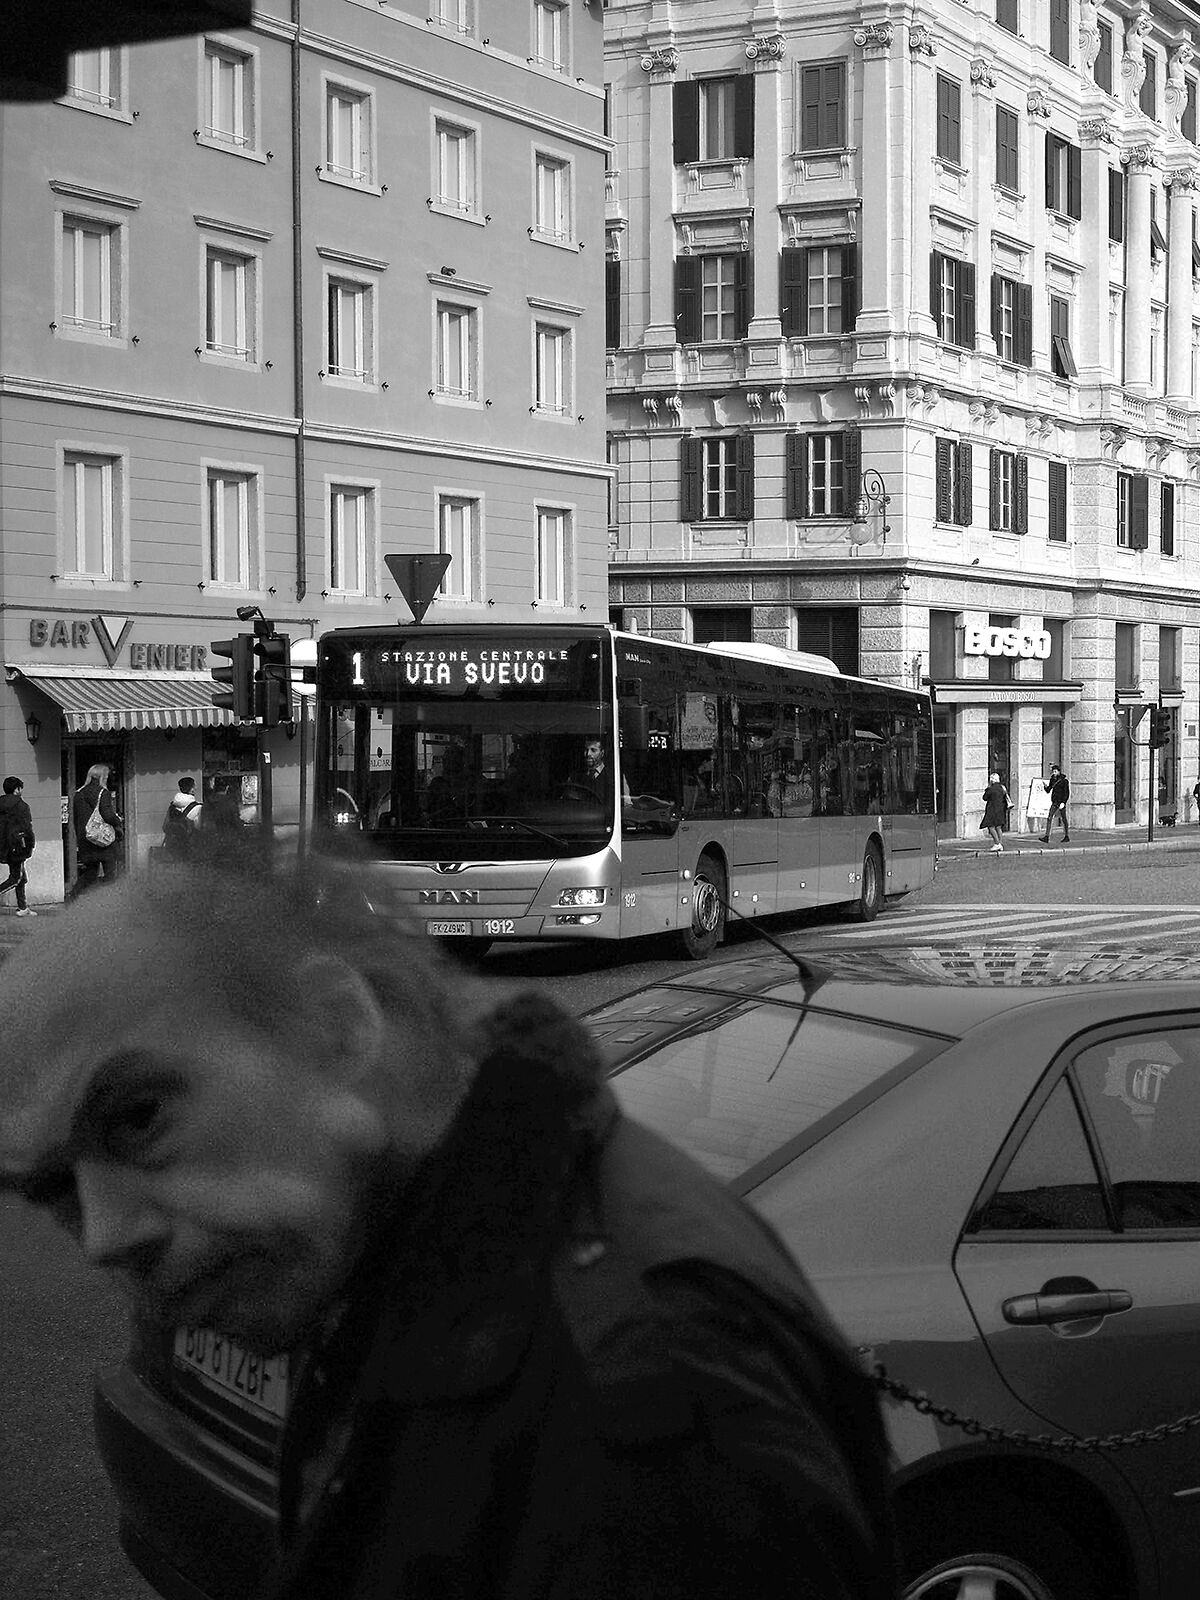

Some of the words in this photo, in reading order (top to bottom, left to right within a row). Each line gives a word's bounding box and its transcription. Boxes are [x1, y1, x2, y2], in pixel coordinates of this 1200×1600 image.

[29, 618, 91, 649] BAR
[964, 624, 1052, 659] BOSCO
[381, 651, 468, 662] STAZIONE
[480, 651, 568, 662] CENTRALE
[352, 652, 364, 685] 1
[406, 663, 450, 684] VIA
[465, 663, 544, 684] SVEVO
[420, 889, 480, 904] MAN
[485, 920, 515, 934] 1912
